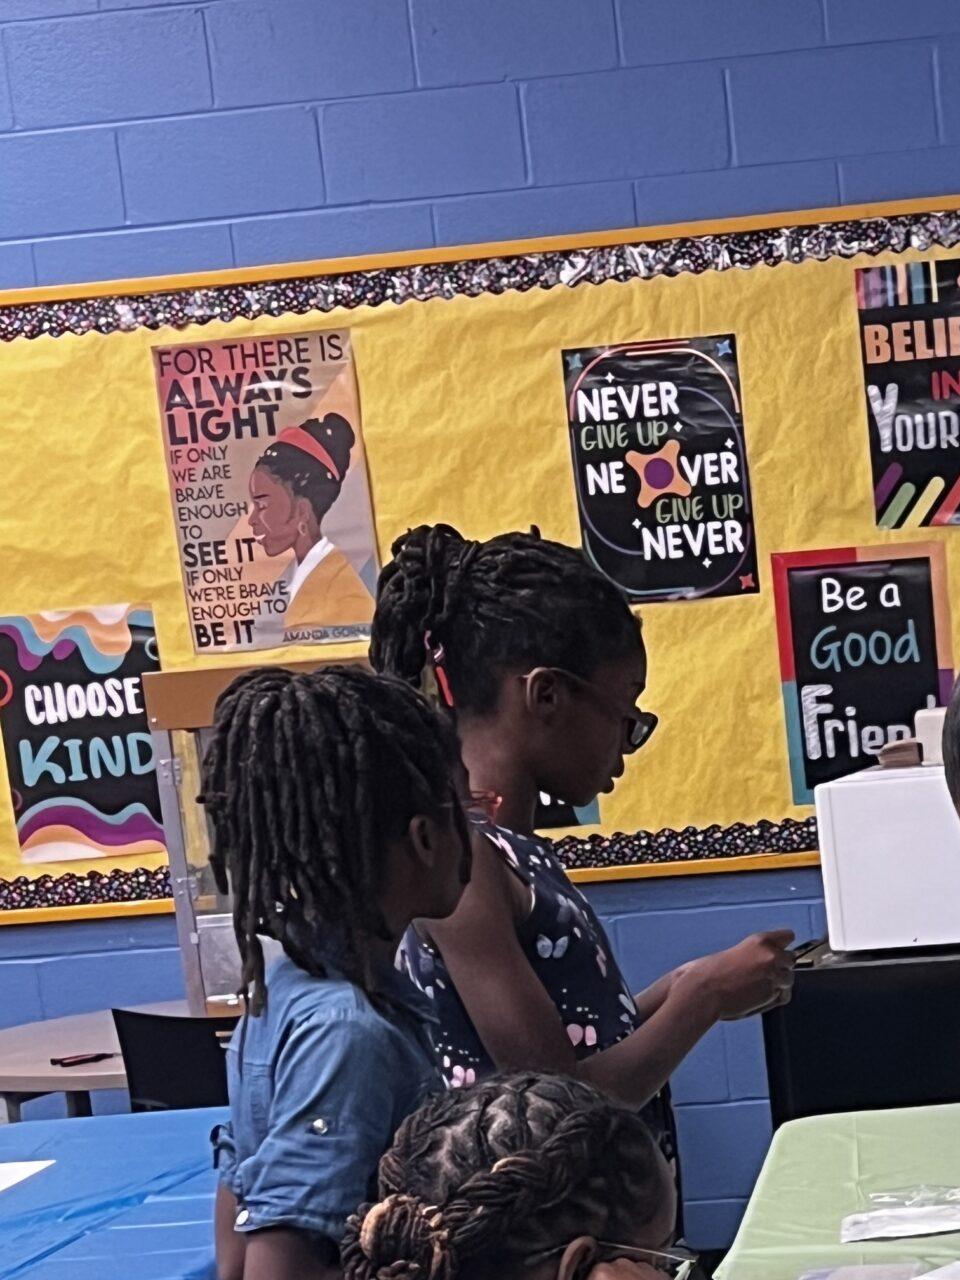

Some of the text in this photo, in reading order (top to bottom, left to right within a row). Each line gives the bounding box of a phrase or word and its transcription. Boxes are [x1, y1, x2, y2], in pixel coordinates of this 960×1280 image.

[158, 334, 343, 377] FOR THERE IS
[165, 367, 312, 412] ALWAYS
[576, 381, 680, 423] NEVER
[167, 404, 280, 446] LIGHT
[580, 420, 669, 450] GIVE UP
[170, 445, 229, 465] IF ONLY
[172, 464, 231, 483] WE ARE
[176, 484, 225, 503] BRAVE
[655, 493, 744, 523] GIVE UP
[178, 501, 249, 522] ENOUGH
[180, 525, 203, 541] TO
[641, 520, 745, 560] NEVER
[183, 537, 256, 568] SEE IT
[186, 566, 244, 586] IF ONLY
[188, 580, 288, 603] WE'RE BRAVE
[821, 577, 901, 614] Be a
[193, 599, 287, 621] ENOUGH TO
[195, 619, 255, 648] BE IT
[283, 629, 330, 642] AMANDA
[810, 619, 920, 672] Good
[24, 677, 144, 726] CHOOSE
[19, 732, 157, 787] KIND
